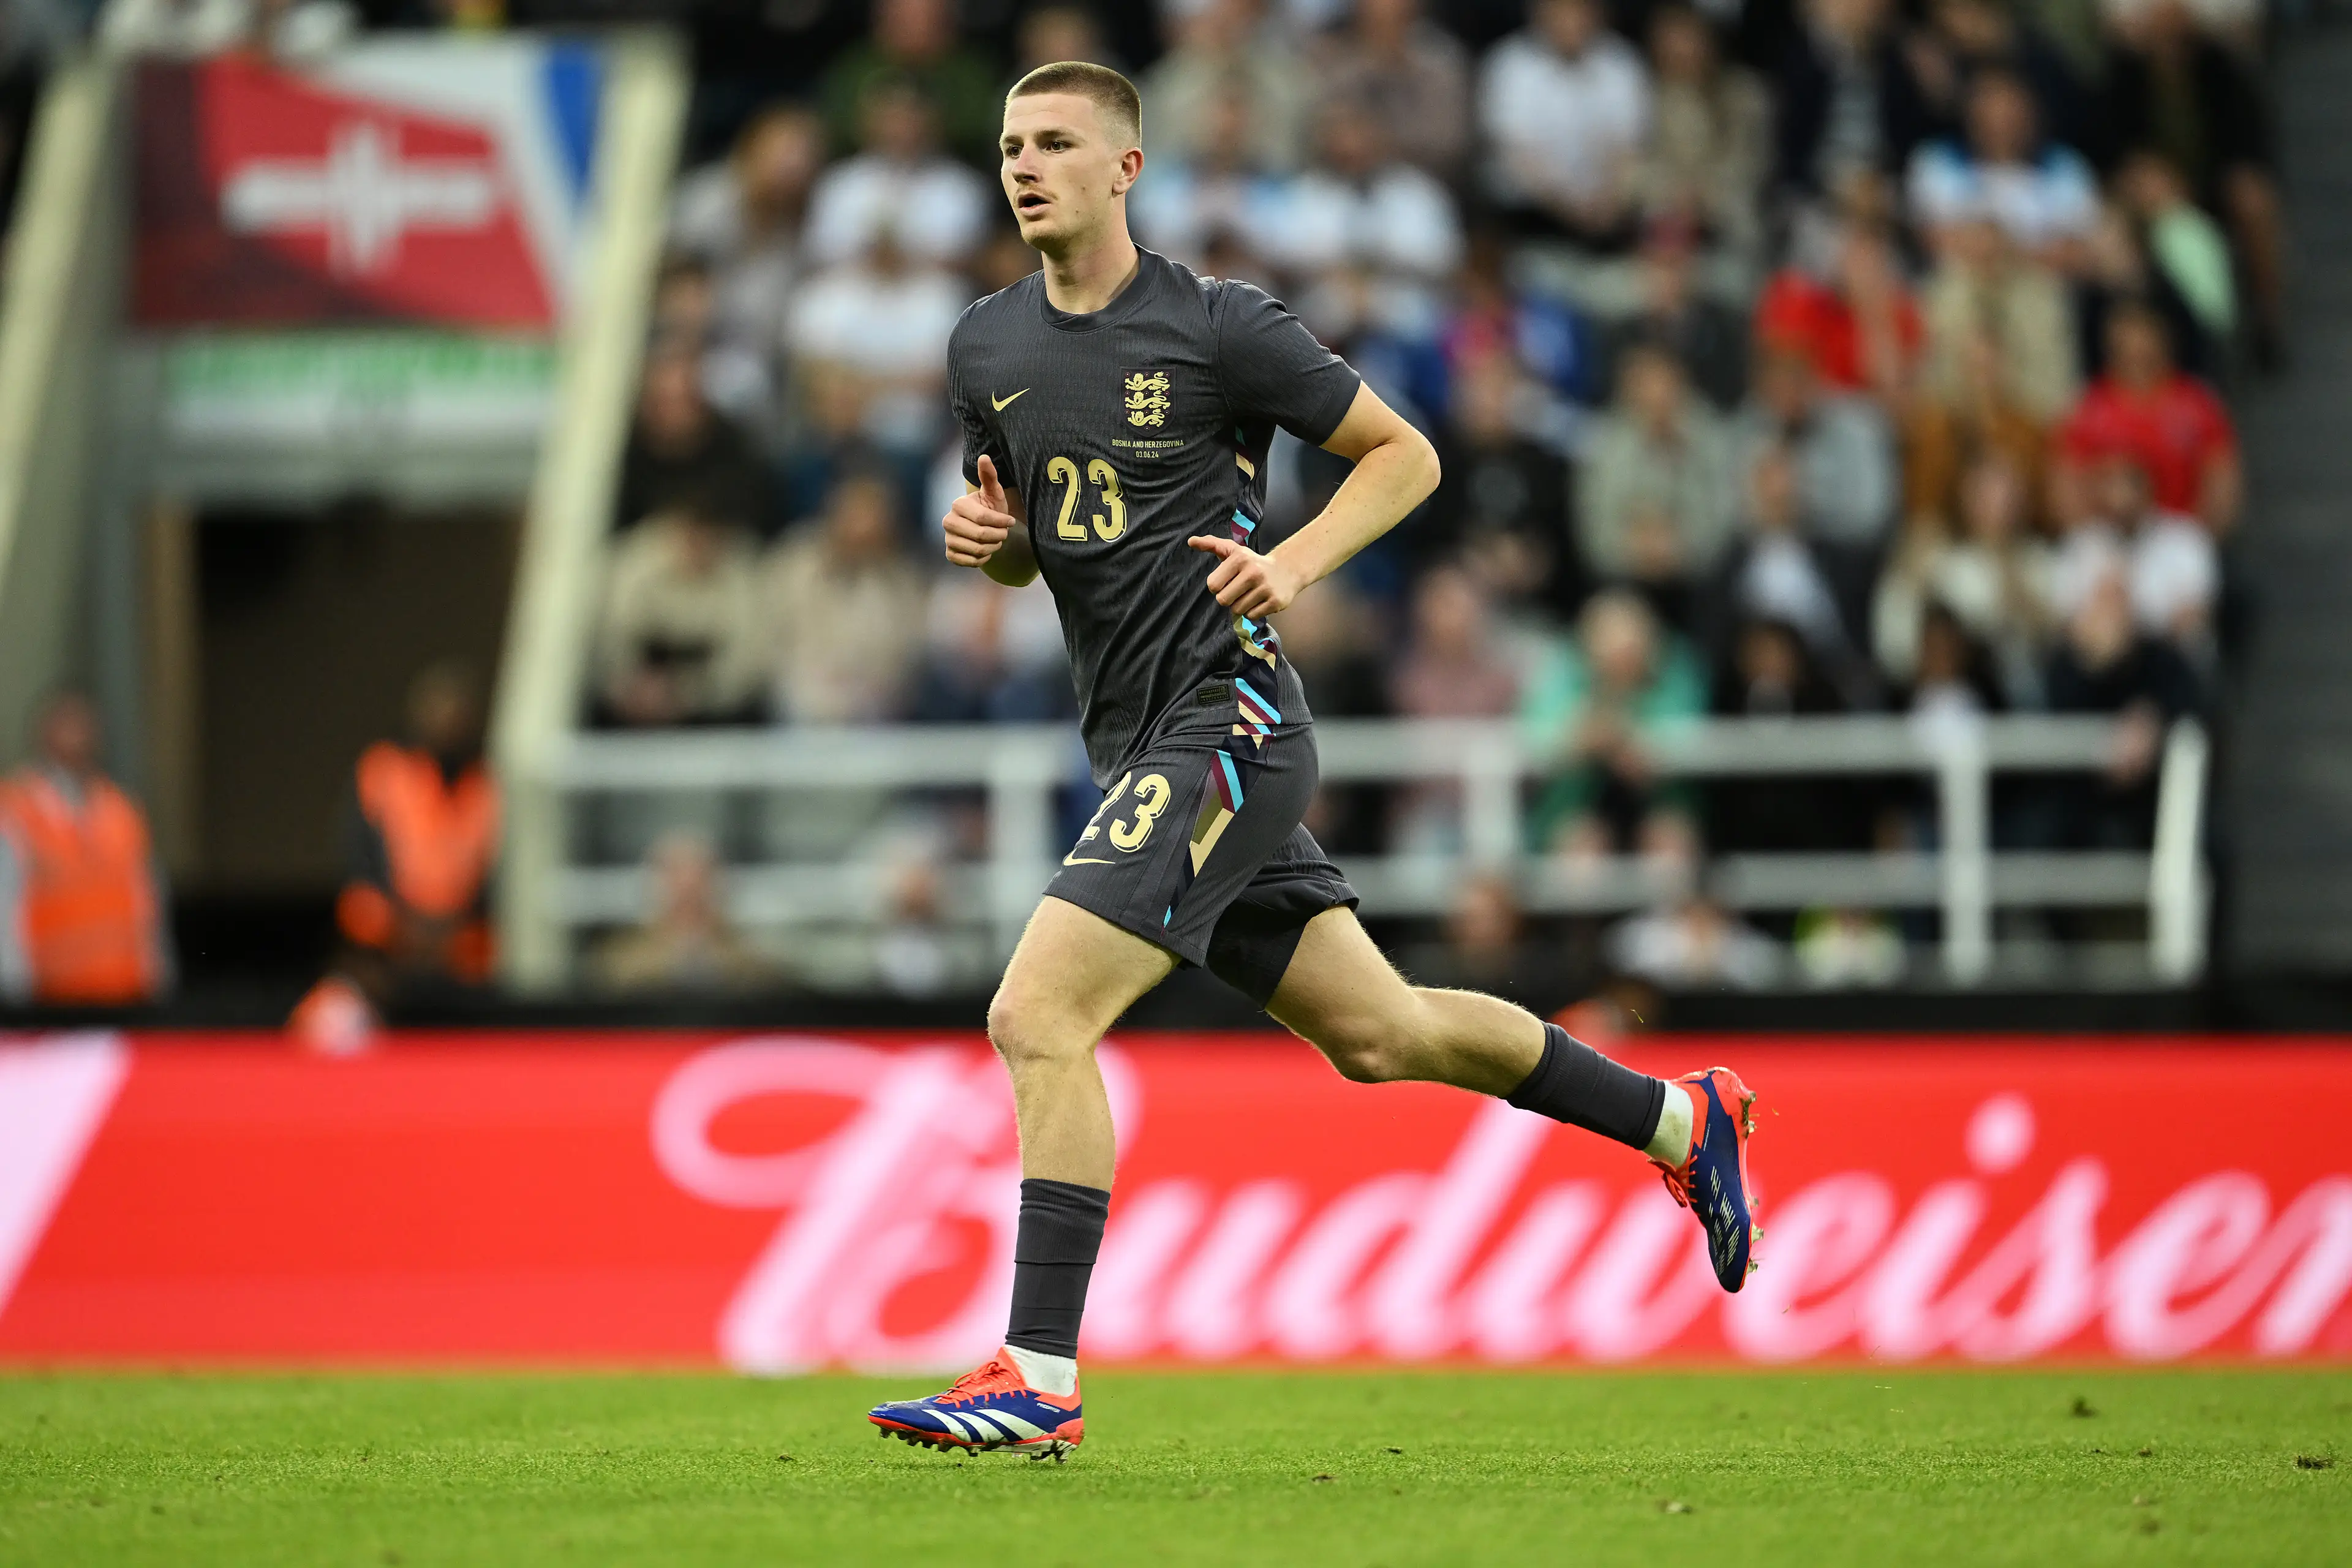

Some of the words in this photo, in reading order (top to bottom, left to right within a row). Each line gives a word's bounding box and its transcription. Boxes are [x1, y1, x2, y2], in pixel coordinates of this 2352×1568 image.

[1112, 439, 1131, 448] BOSNIA
[1145, 440, 1184, 448] HERZEGOVINA
[1047, 456, 1127, 543] 23
